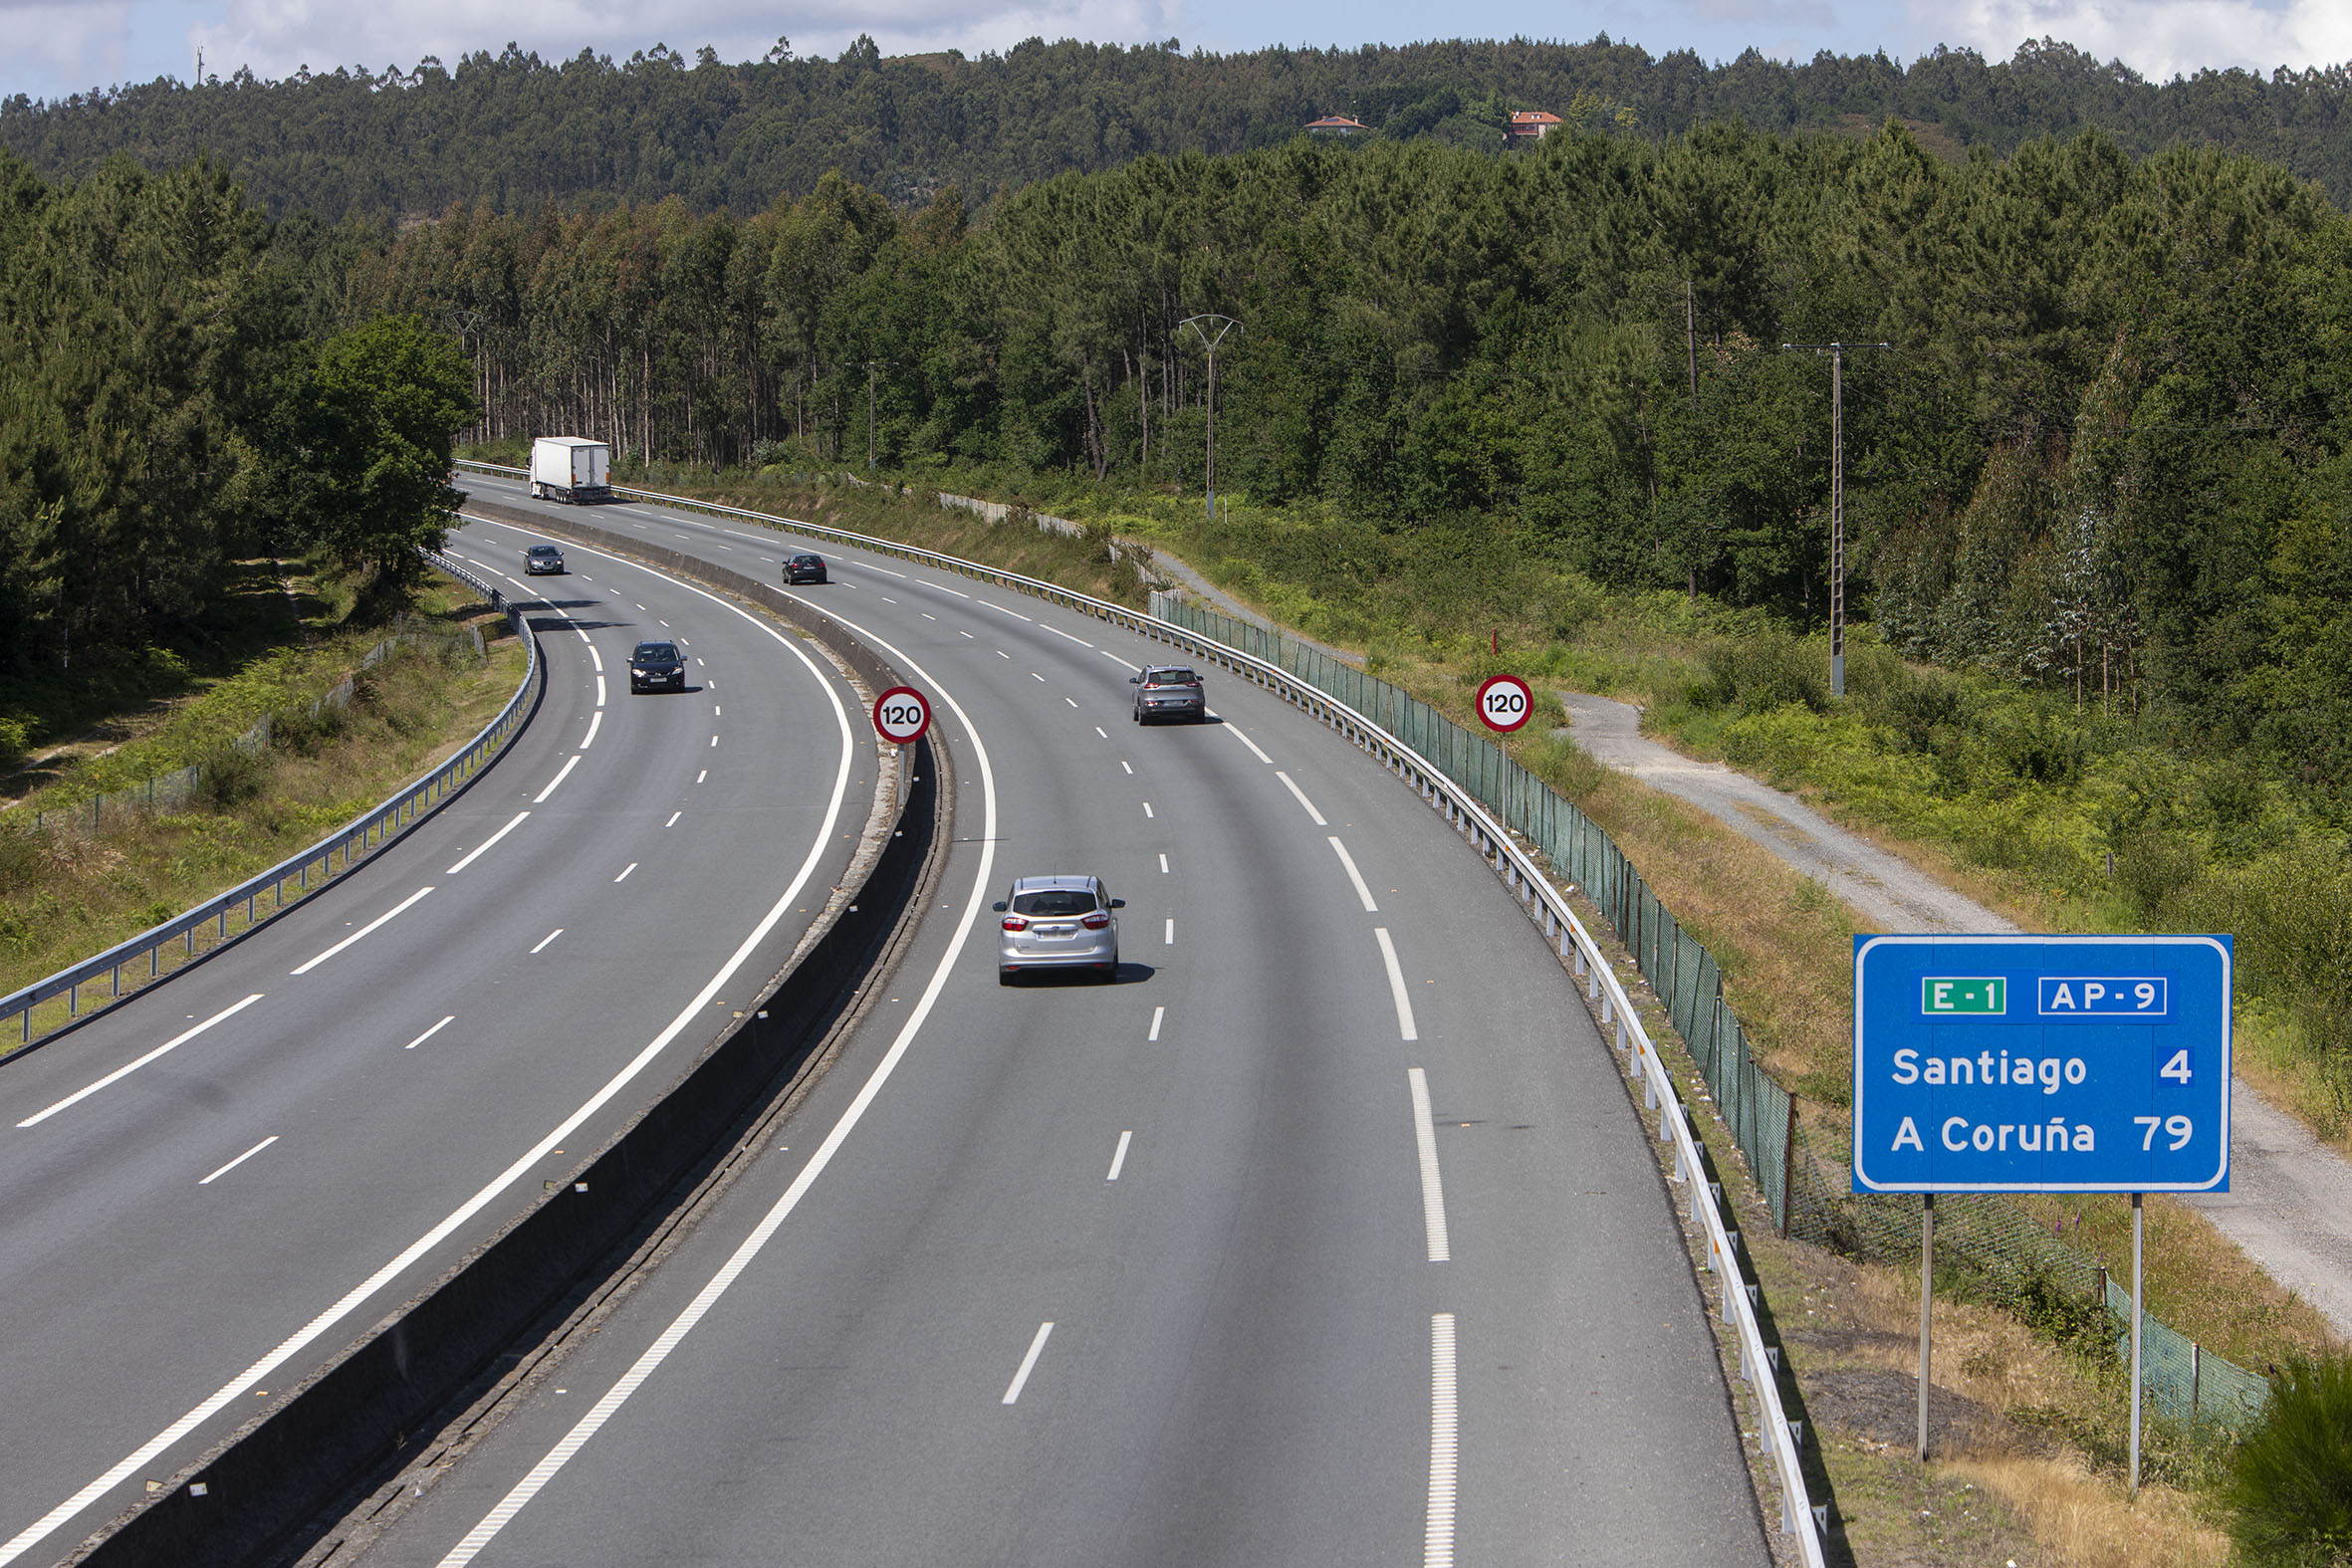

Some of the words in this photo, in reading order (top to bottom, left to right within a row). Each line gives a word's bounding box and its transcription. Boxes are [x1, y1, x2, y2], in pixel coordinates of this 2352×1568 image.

[883, 706, 921, 725] 120
[1486, 694, 1524, 713] 120
[1934, 983, 1996, 1009] E-1
[2051, 983, 2155, 1009] AP-9
[1891, 1048, 2087, 1095] Santiago
[2159, 1049, 2193, 1084] 4
[1890, 1116, 1925, 1152] A
[1942, 1116, 2095, 1152] Coruña
[2134, 1115, 2193, 1152] 79
